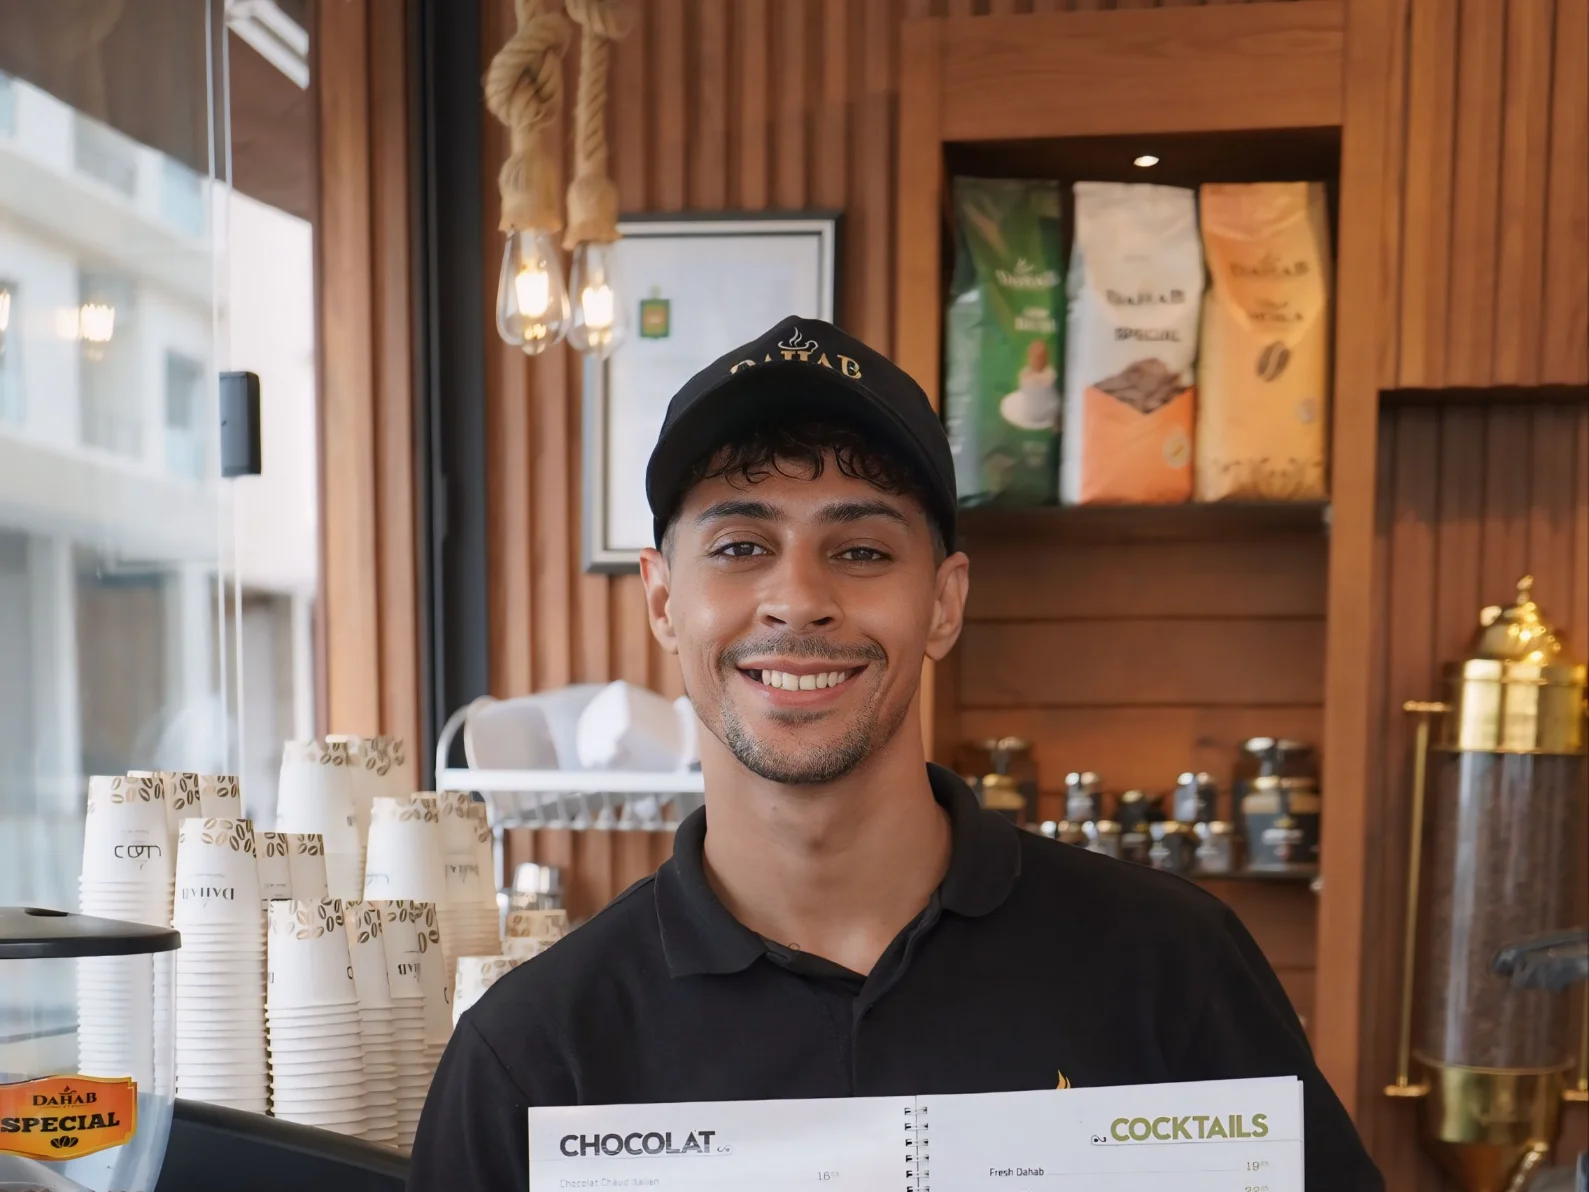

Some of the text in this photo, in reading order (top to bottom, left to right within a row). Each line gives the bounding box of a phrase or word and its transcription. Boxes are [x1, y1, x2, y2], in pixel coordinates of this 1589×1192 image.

[32, 1091, 97, 1106] DAHAB
[0, 1112, 120, 1133] SPECIAL
[1110, 1113, 1269, 1142] COCKTAILS
[559, 1130, 716, 1157] CHOCOLAT
[989, 1167, 1014, 1177] Fresh
[1016, 1167, 1045, 1177] Dahab
